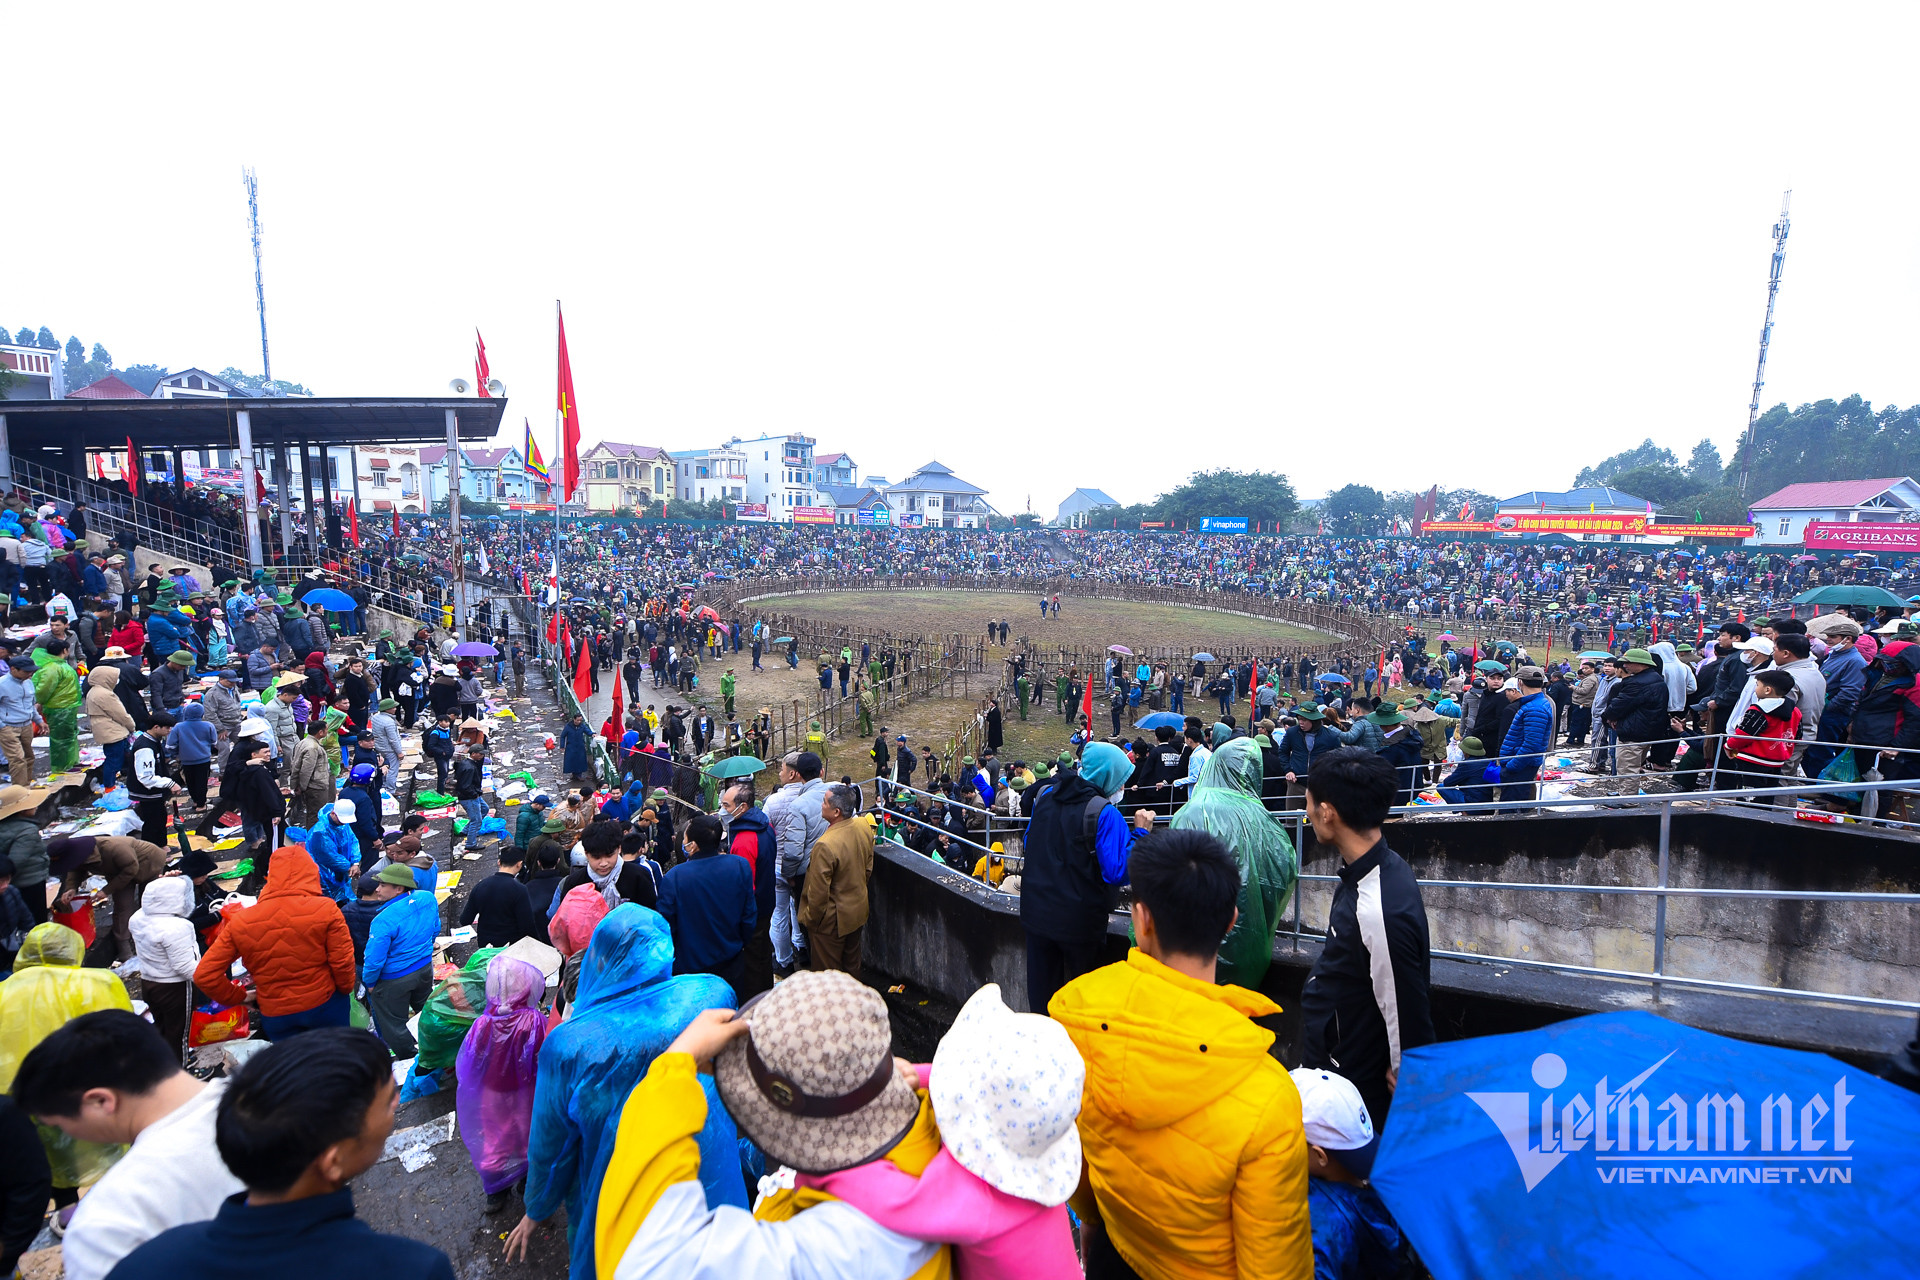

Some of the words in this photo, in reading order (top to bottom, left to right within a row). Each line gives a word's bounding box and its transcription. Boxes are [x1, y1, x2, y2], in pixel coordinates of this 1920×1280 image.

[1212, 520, 1246, 529] vinaphone
[1518, 517, 1523, 528] LỄ
[1612, 521, 1623, 530] 2024
[1830, 532, 1918, 542] AGRIBANK
[143, 761, 153, 769] M
